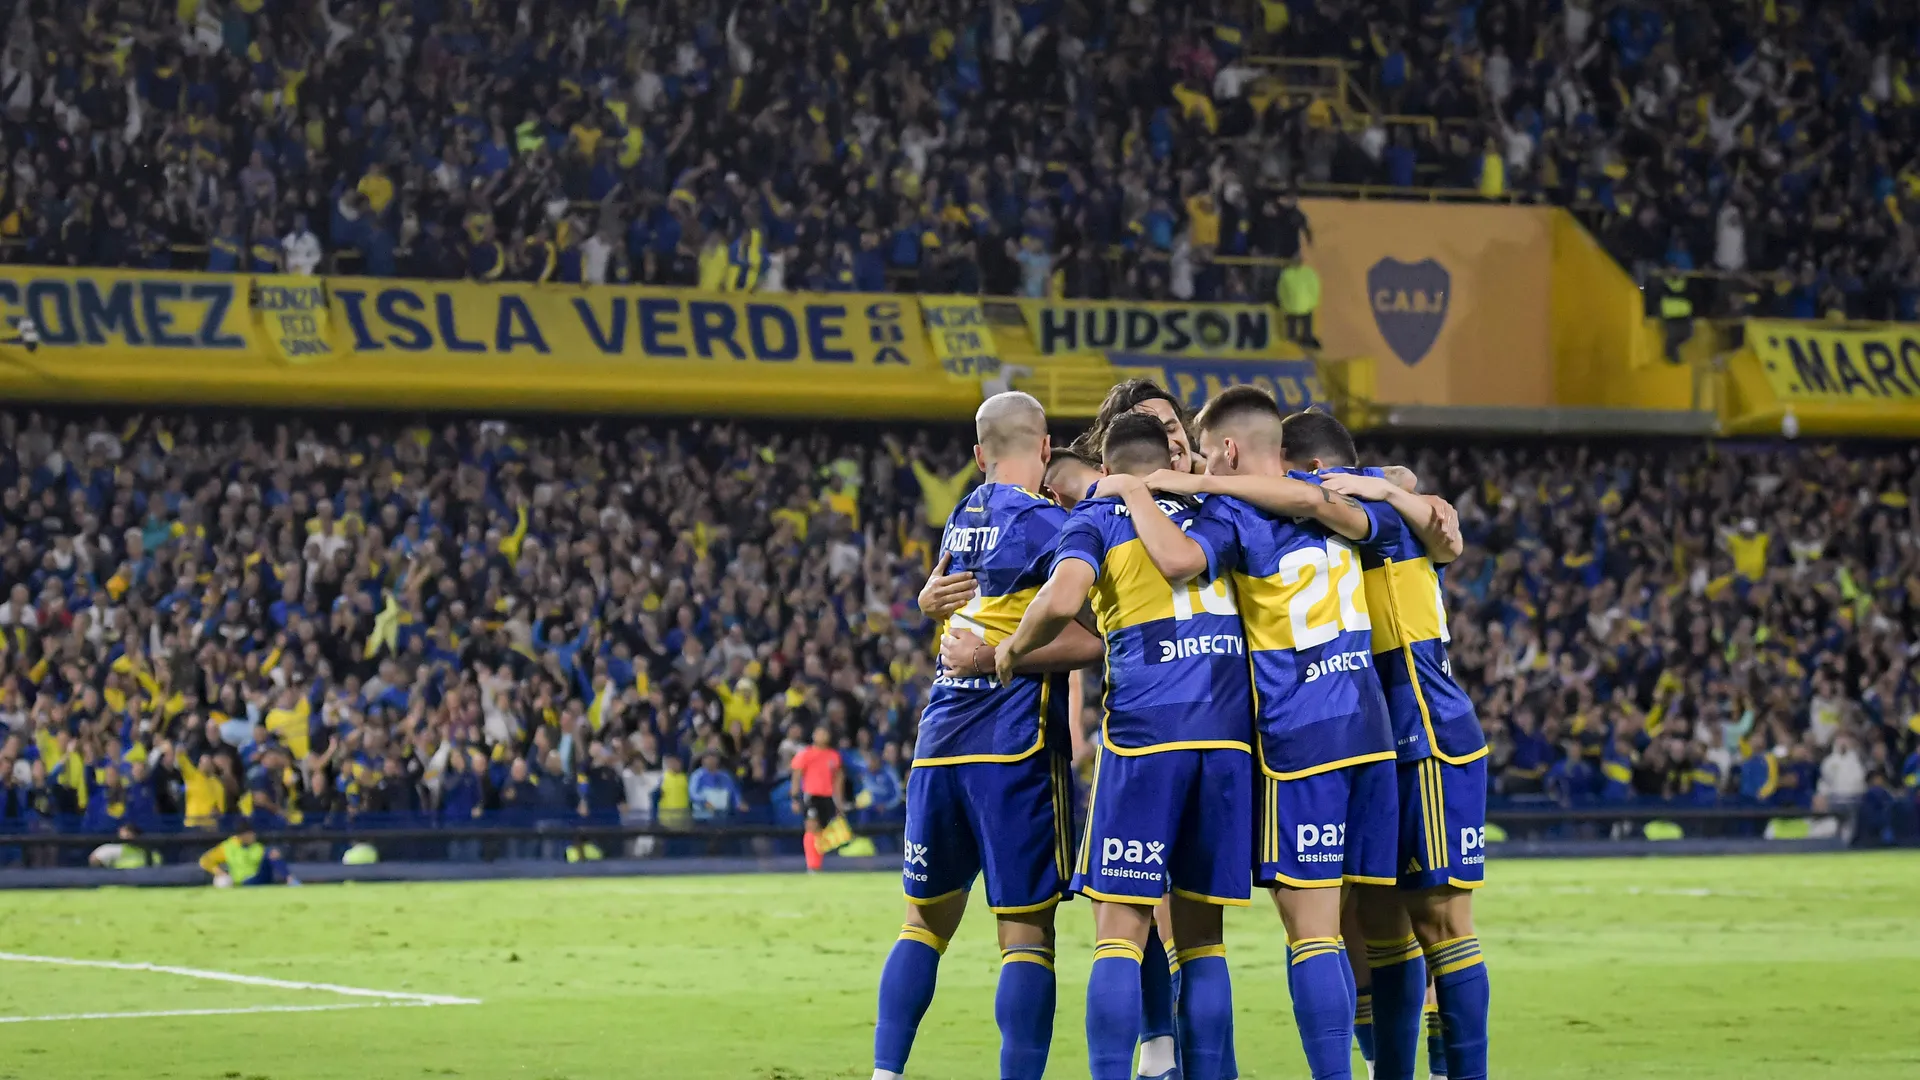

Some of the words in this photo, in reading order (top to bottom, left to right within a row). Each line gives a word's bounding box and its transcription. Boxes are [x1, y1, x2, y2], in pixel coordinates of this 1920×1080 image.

[333, 289, 551, 354] ISLA
[572, 297, 855, 363] VERDE
[1041, 308, 1269, 353] HUDSON
[1159, 634, 1243, 662] DIRECTV
[1304, 649, 1370, 683] DIRECT
[1102, 837, 1165, 866] pax
[1461, 826, 1485, 856] pa
[1101, 866, 1162, 881] assistance
